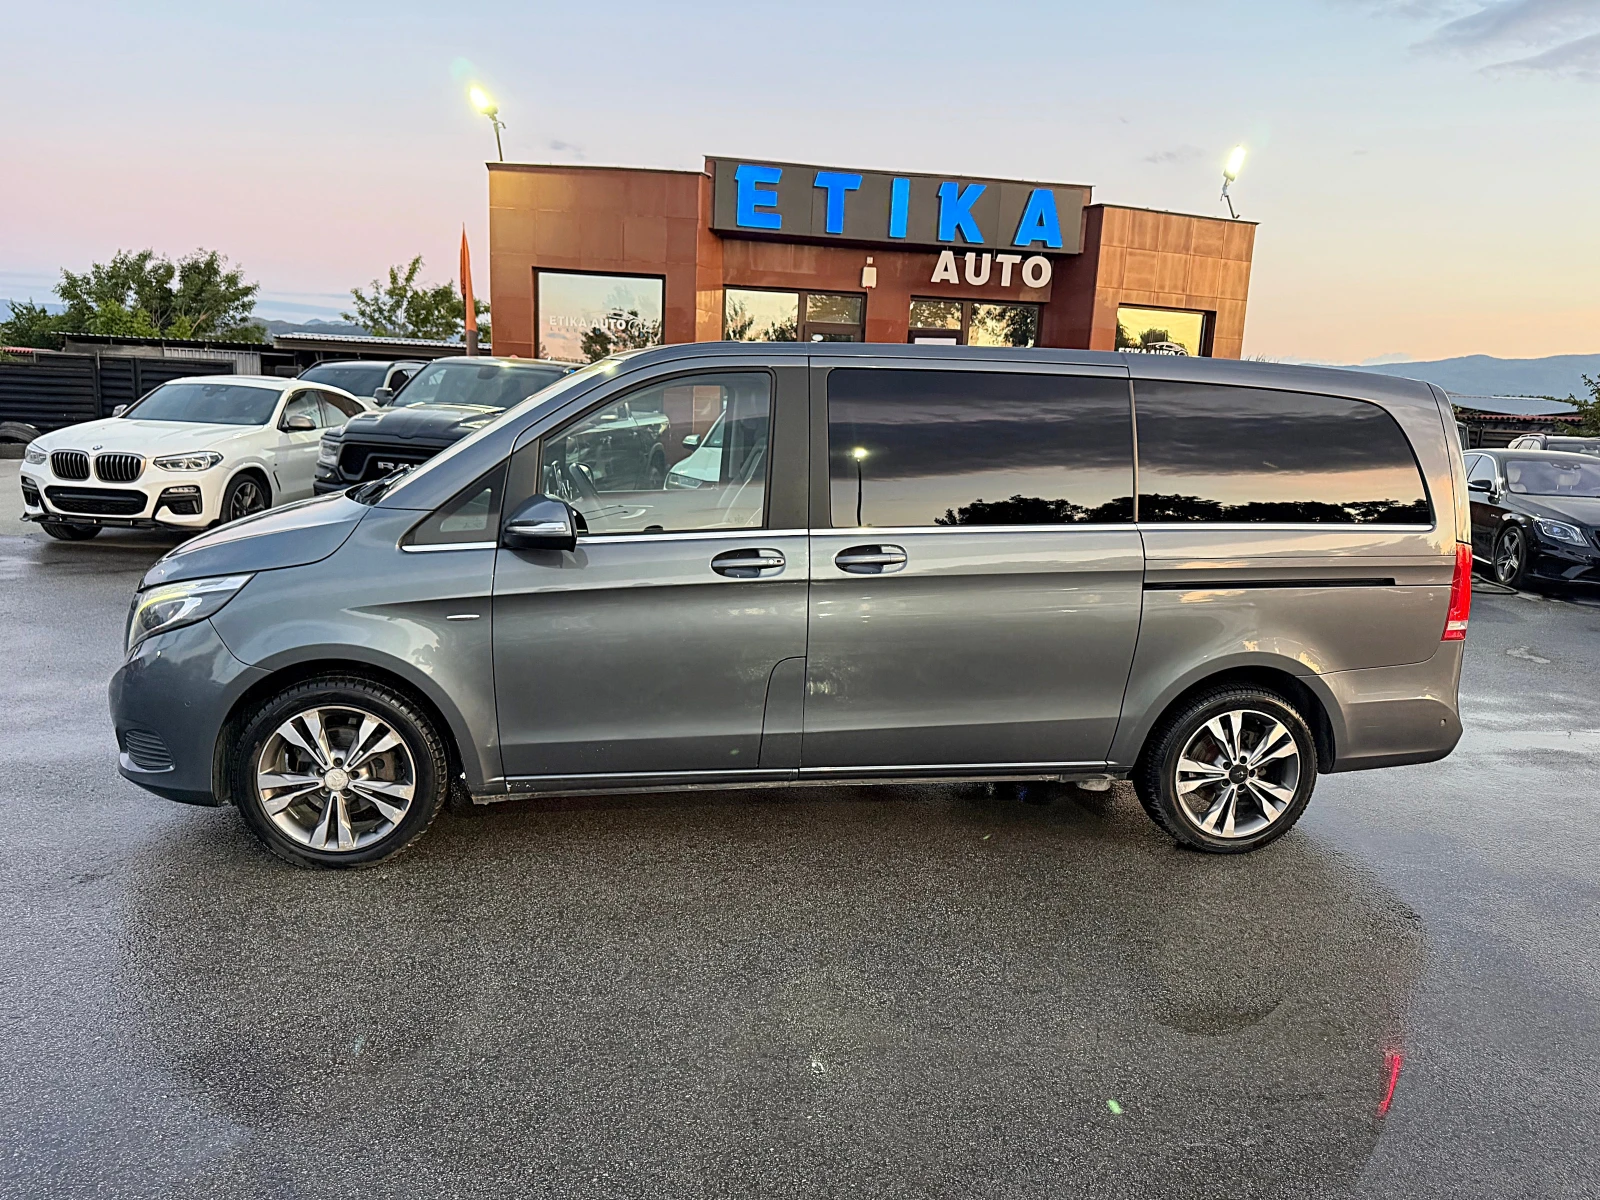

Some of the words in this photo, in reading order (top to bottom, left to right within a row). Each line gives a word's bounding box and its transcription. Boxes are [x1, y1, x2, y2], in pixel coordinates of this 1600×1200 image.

[735, 164, 1062, 248] ETIKA
[931, 250, 1052, 288] AUTO
[549, 315, 587, 327] ETIKA
[591, 318, 626, 330] AUTO
